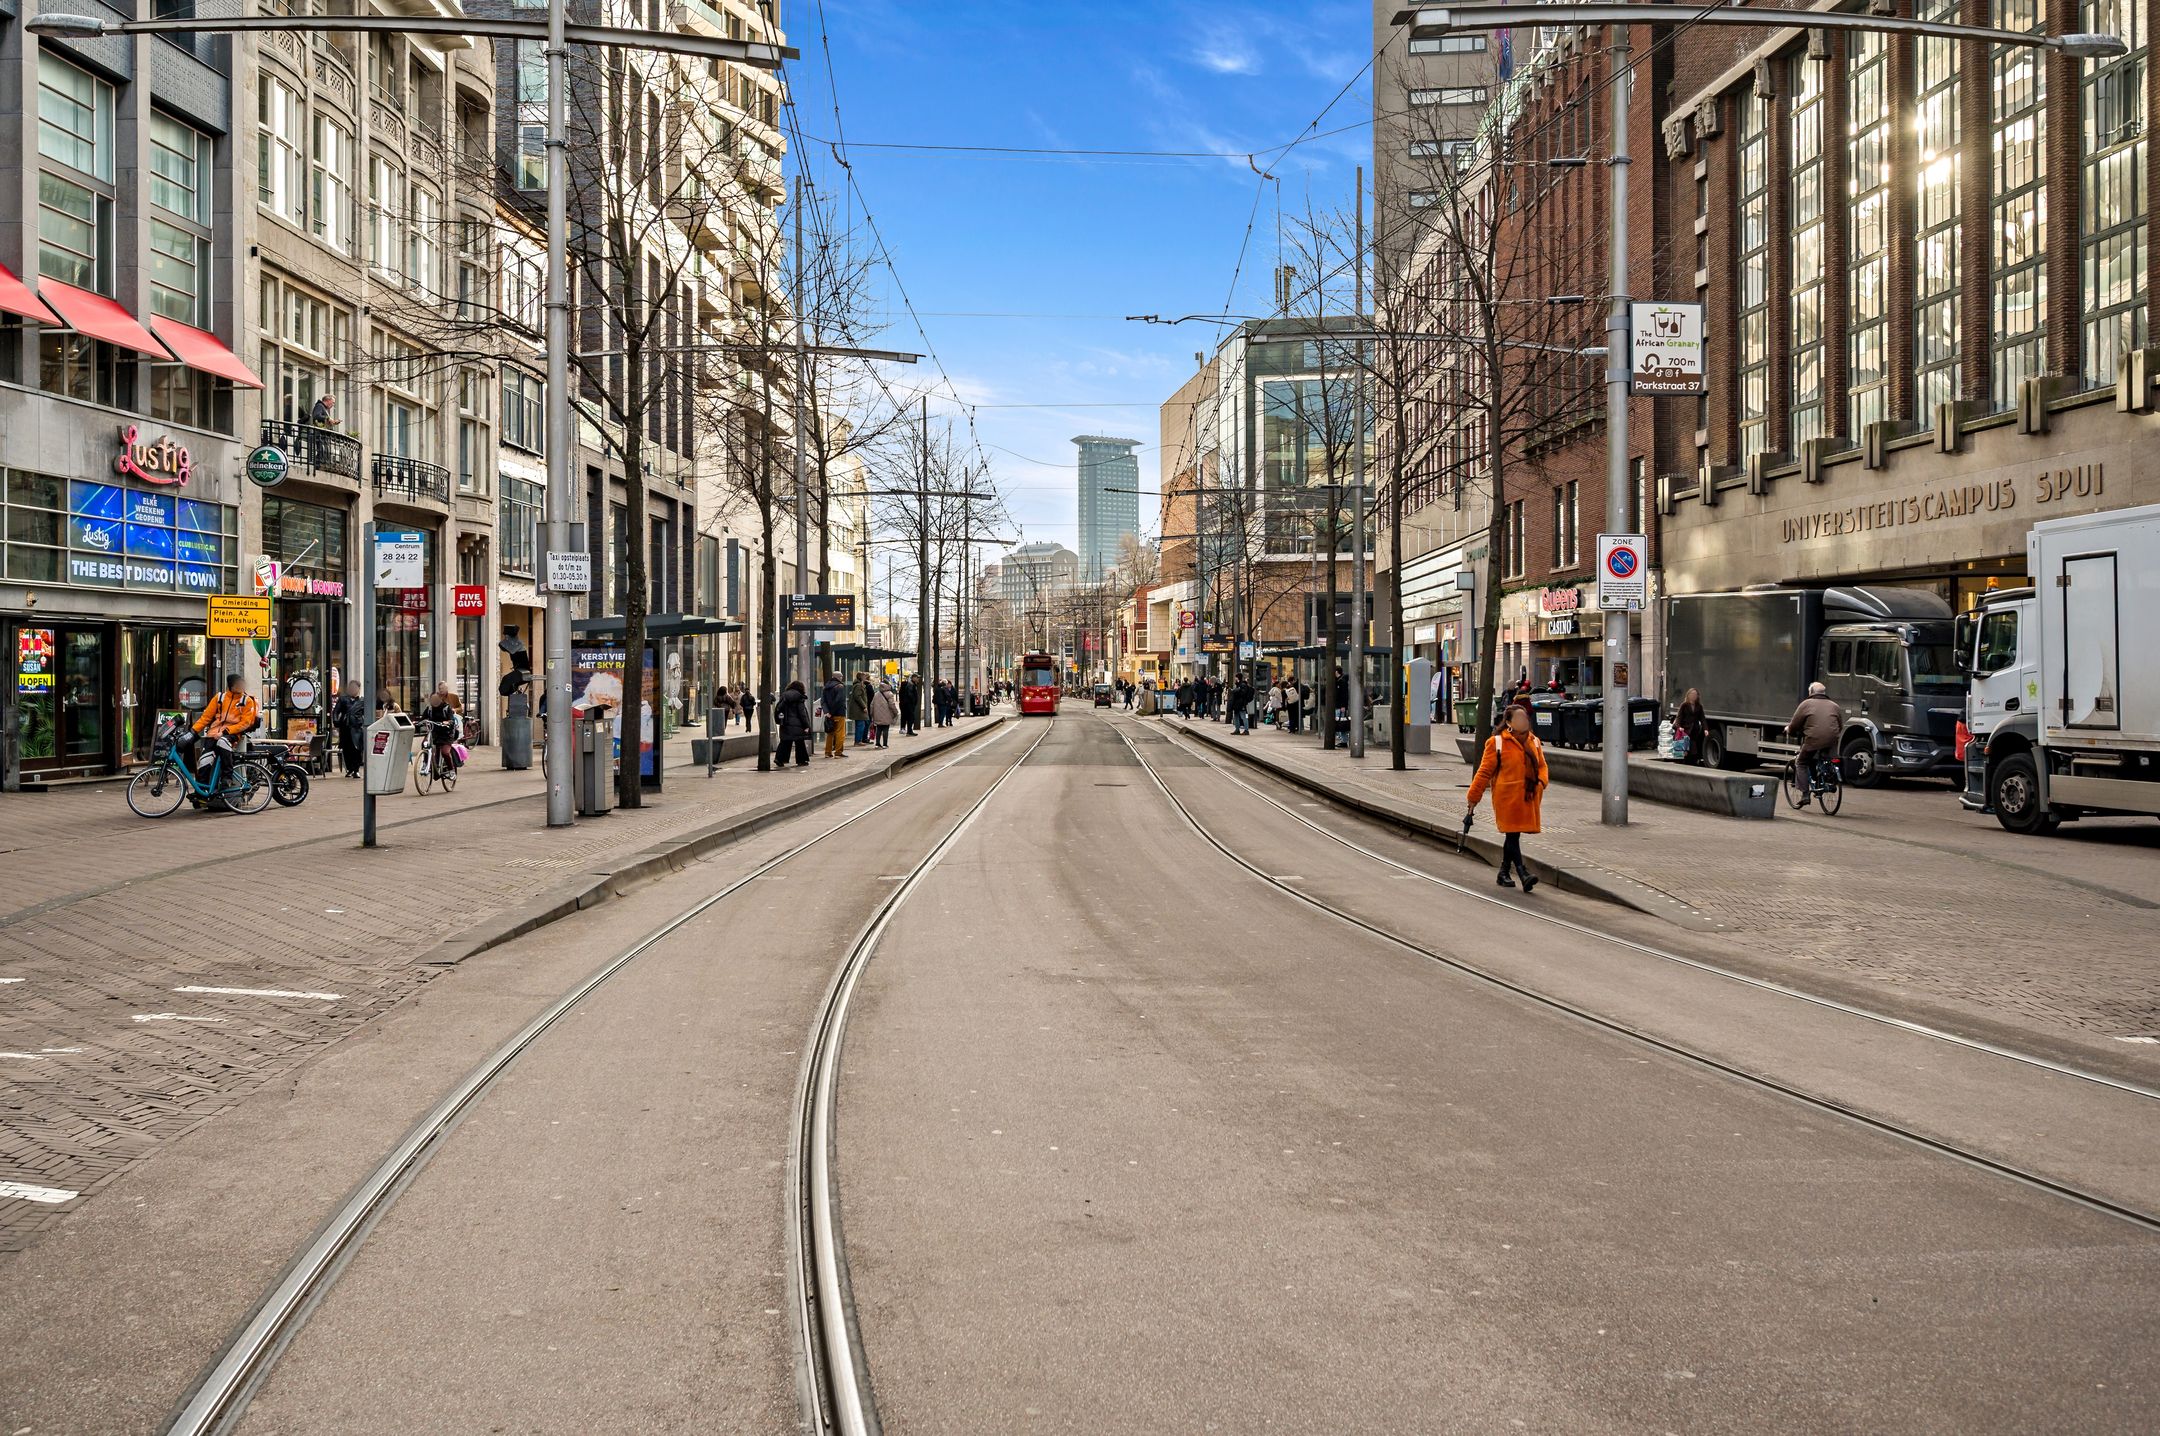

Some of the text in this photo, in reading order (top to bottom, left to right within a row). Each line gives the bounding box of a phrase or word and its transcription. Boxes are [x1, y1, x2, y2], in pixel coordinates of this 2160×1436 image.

[1635, 339, 1700, 350] African Granary
[1635, 381, 1700, 390] Parkstraat 37
[114, 424, 192, 487] Lustig
[250, 462, 284, 470] Heineken
[142, 497, 158, 506] ELKE
[1781, 462, 2103, 543] UNIVERSITEITSCAMPUS SPUI
[135, 504, 165, 516] WEEKEND
[135, 513, 165, 525] GEOPEND!
[82, 523, 113, 549] Lustig
[383, 553, 418, 561] 28 24 22
[72, 559, 217, 588] THE BEST DISCO IN TOWN
[552, 572, 583, 581] 01.30-05.30
[1542, 587, 1578, 612] Queens
[1548, 620, 1572, 636] CASINO
[22, 662, 41, 672] SUSAN
[578, 661, 596, 669] MET
[597, 661, 614, 669] SKY
